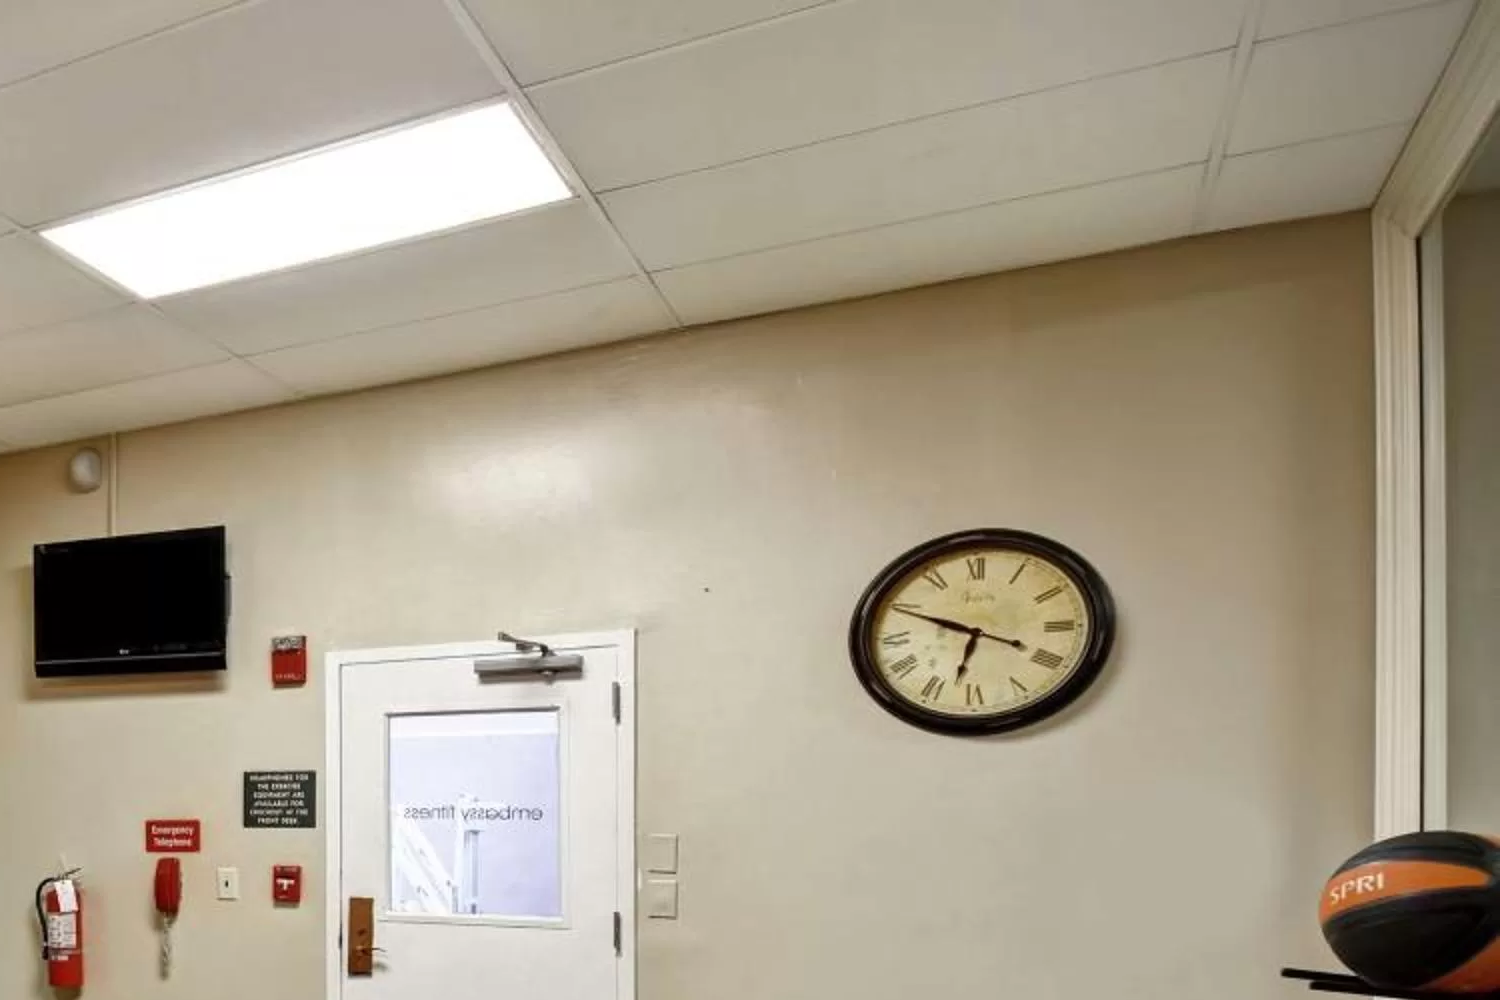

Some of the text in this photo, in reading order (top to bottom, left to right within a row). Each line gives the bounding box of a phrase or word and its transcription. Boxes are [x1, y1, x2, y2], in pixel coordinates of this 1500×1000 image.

[966, 557, 986, 580] XII
[151, 824, 195, 836] Emergency
[1329, 872, 1385, 905] SPRI
